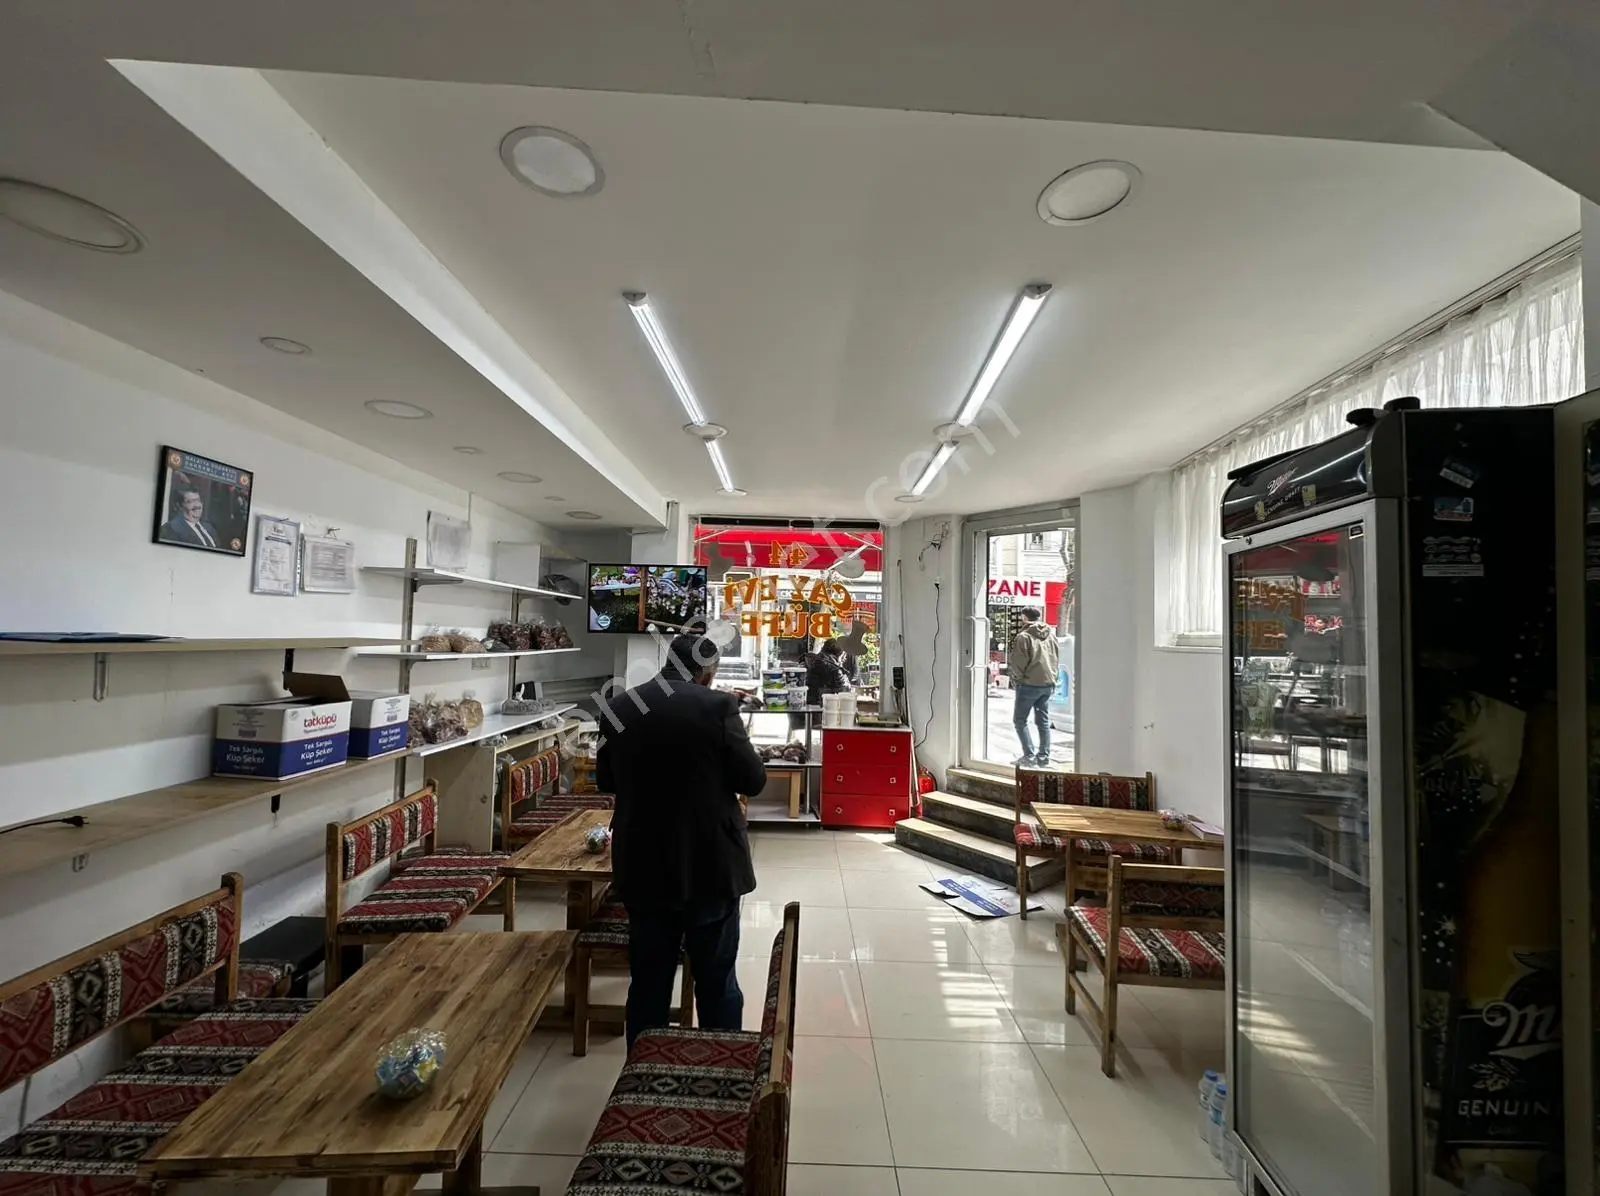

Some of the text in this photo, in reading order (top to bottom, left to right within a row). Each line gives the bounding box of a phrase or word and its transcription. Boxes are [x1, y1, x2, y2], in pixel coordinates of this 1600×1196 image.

[988, 579, 1041, 597] ZANE
[303, 713, 337, 728] tatküpü
[301, 751, 315, 760] Küp
